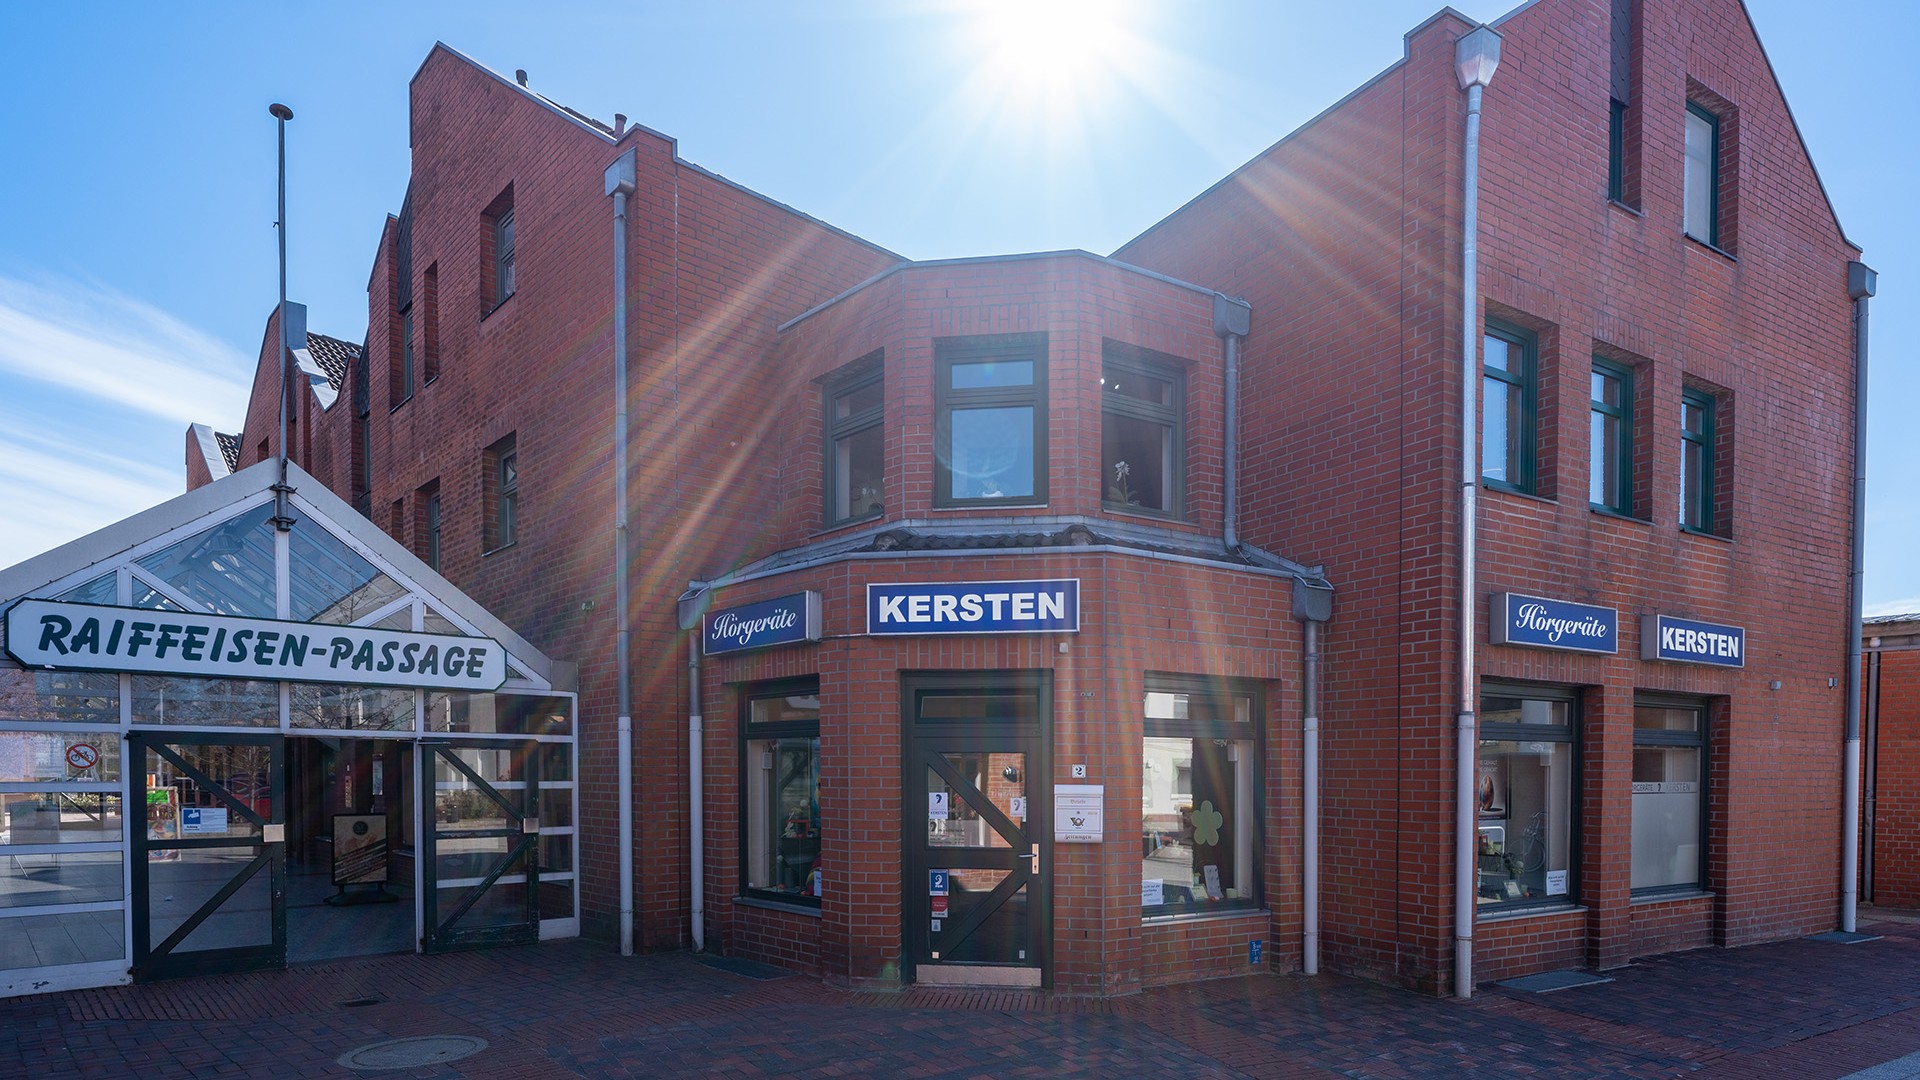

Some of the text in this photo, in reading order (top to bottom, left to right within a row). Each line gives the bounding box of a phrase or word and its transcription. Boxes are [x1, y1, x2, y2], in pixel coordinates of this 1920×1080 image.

[879, 591, 1065, 623] KERSTEN
[1515, 603, 1609, 643] Hörgeräte
[711, 608, 798, 646] Hörgeräte
[1662, 626, 1739, 658] KERSTEN
[38, 614, 488, 678] RAIFFEISEN-PASSAGE
[1075, 766, 1082, 775] 2
